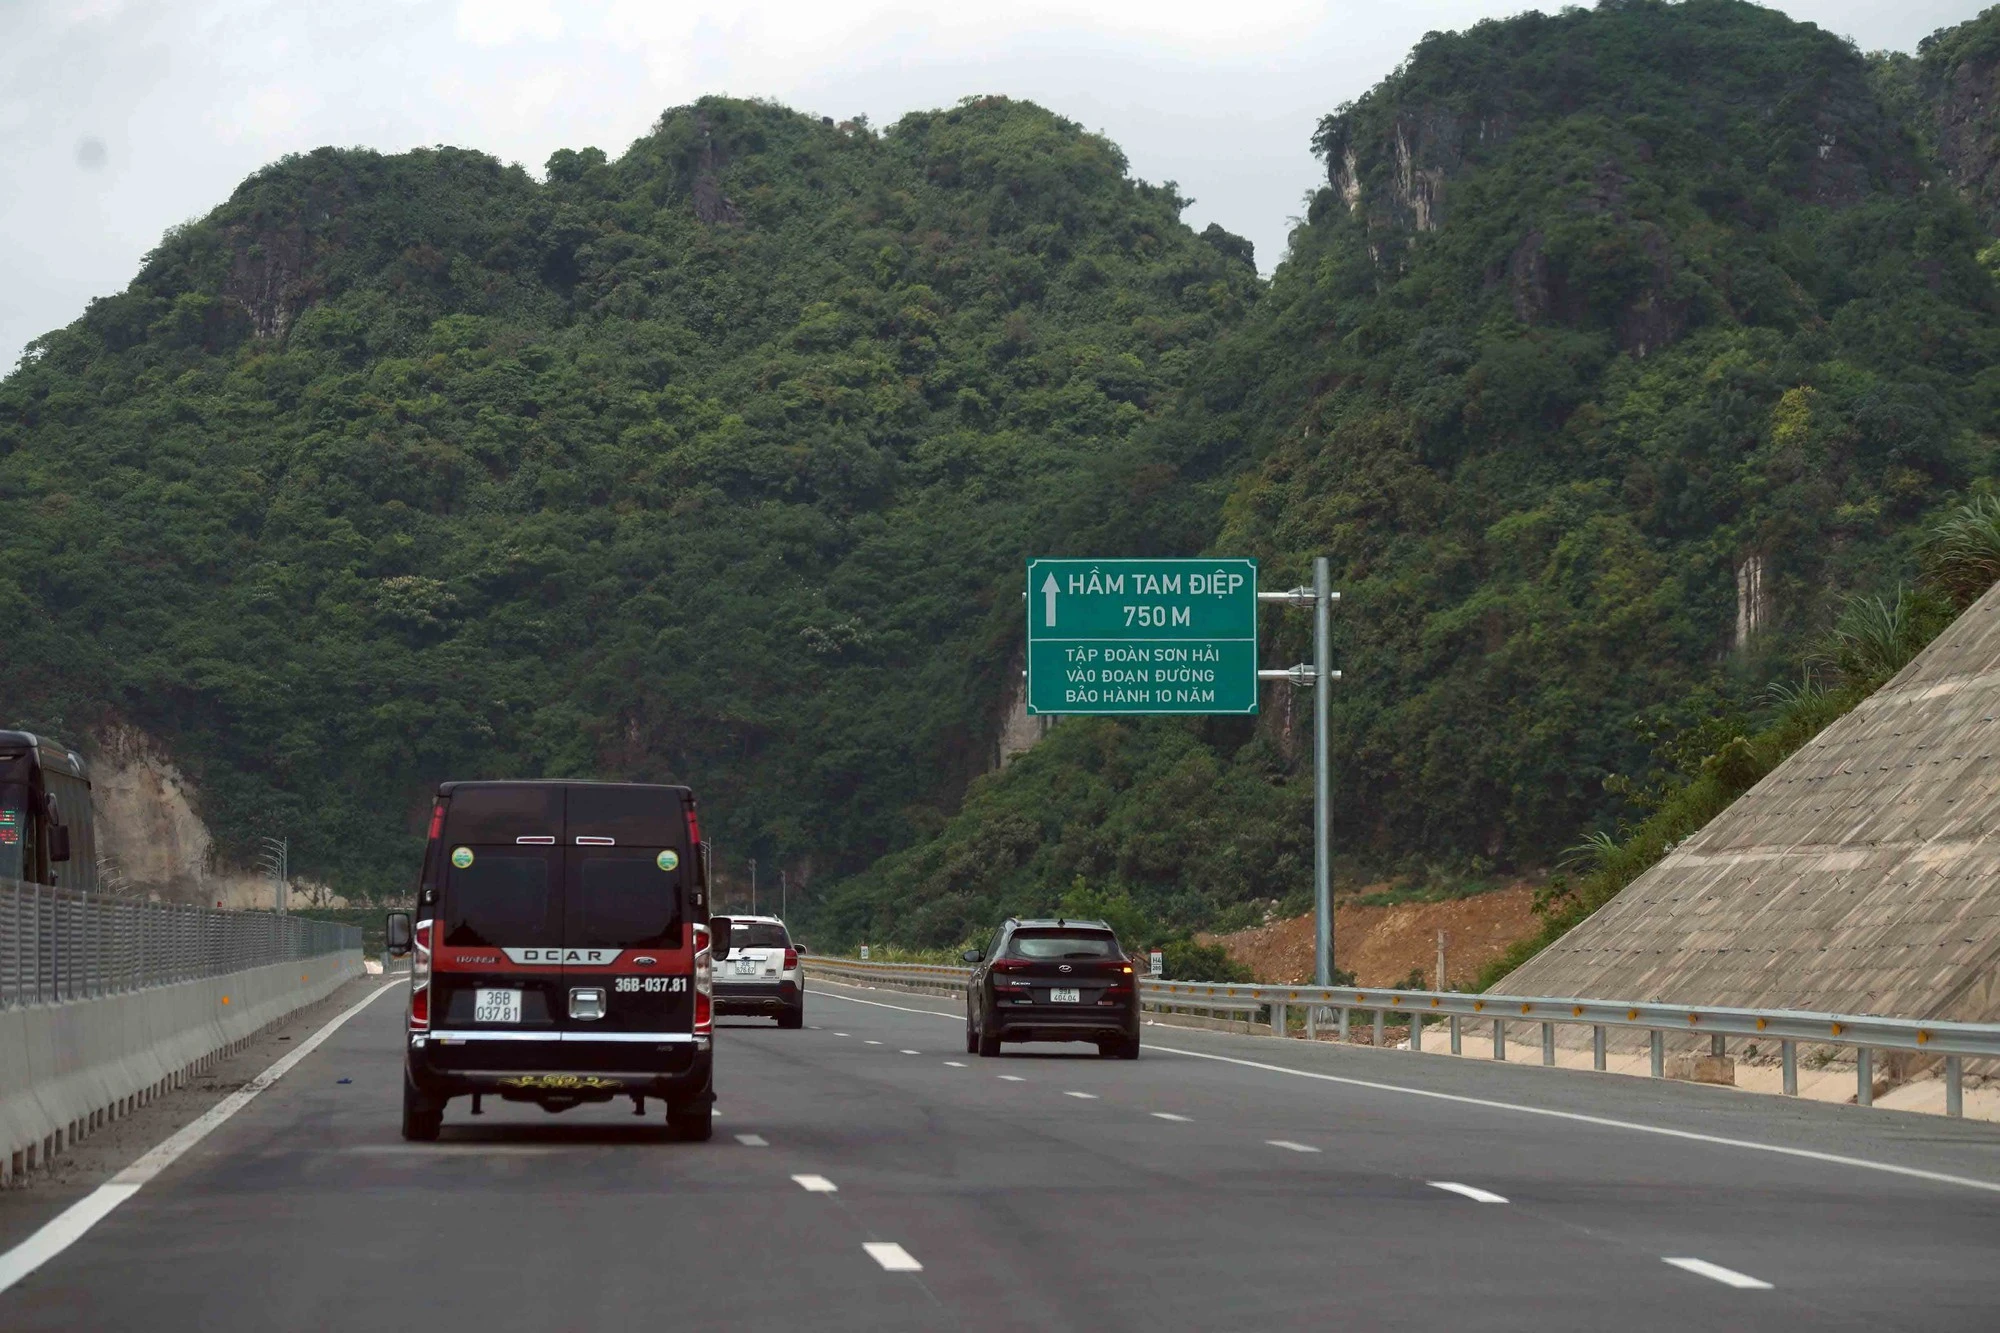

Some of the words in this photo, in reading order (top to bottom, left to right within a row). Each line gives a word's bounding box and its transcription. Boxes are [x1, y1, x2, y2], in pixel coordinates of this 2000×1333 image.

[1068, 566, 1124, 595] HẦM
[1132, 574, 1181, 594] TAM
[1189, 569, 1244, 599] ĐIỆP
[1123, 606, 1166, 627] 750
[1172, 606, 1190, 627] M
[1065, 646, 1098, 664] TẬP
[1104, 645, 1150, 662] ĐOÀN
[1154, 647, 1187, 662] SƠN
[1192, 644, 1219, 662] HẢI
[1066, 666, 1096, 682] VÀO
[1102, 669, 1149, 685] ĐOẠN
[1155, 665, 1215, 682] ĐƯỜNG
[1065, 685, 1098, 703] BẢO
[1103, 686, 1149, 702] HÀNH
[1156, 689, 1172, 702] 10
[1177, 686, 1215, 702] NĂM
[524, 950, 602, 961] DCAR
[615, 978, 687, 992] 36B-037.81
[486, 992, 511, 1005] 36B
[476, 1007, 518, 1021] 037.81
